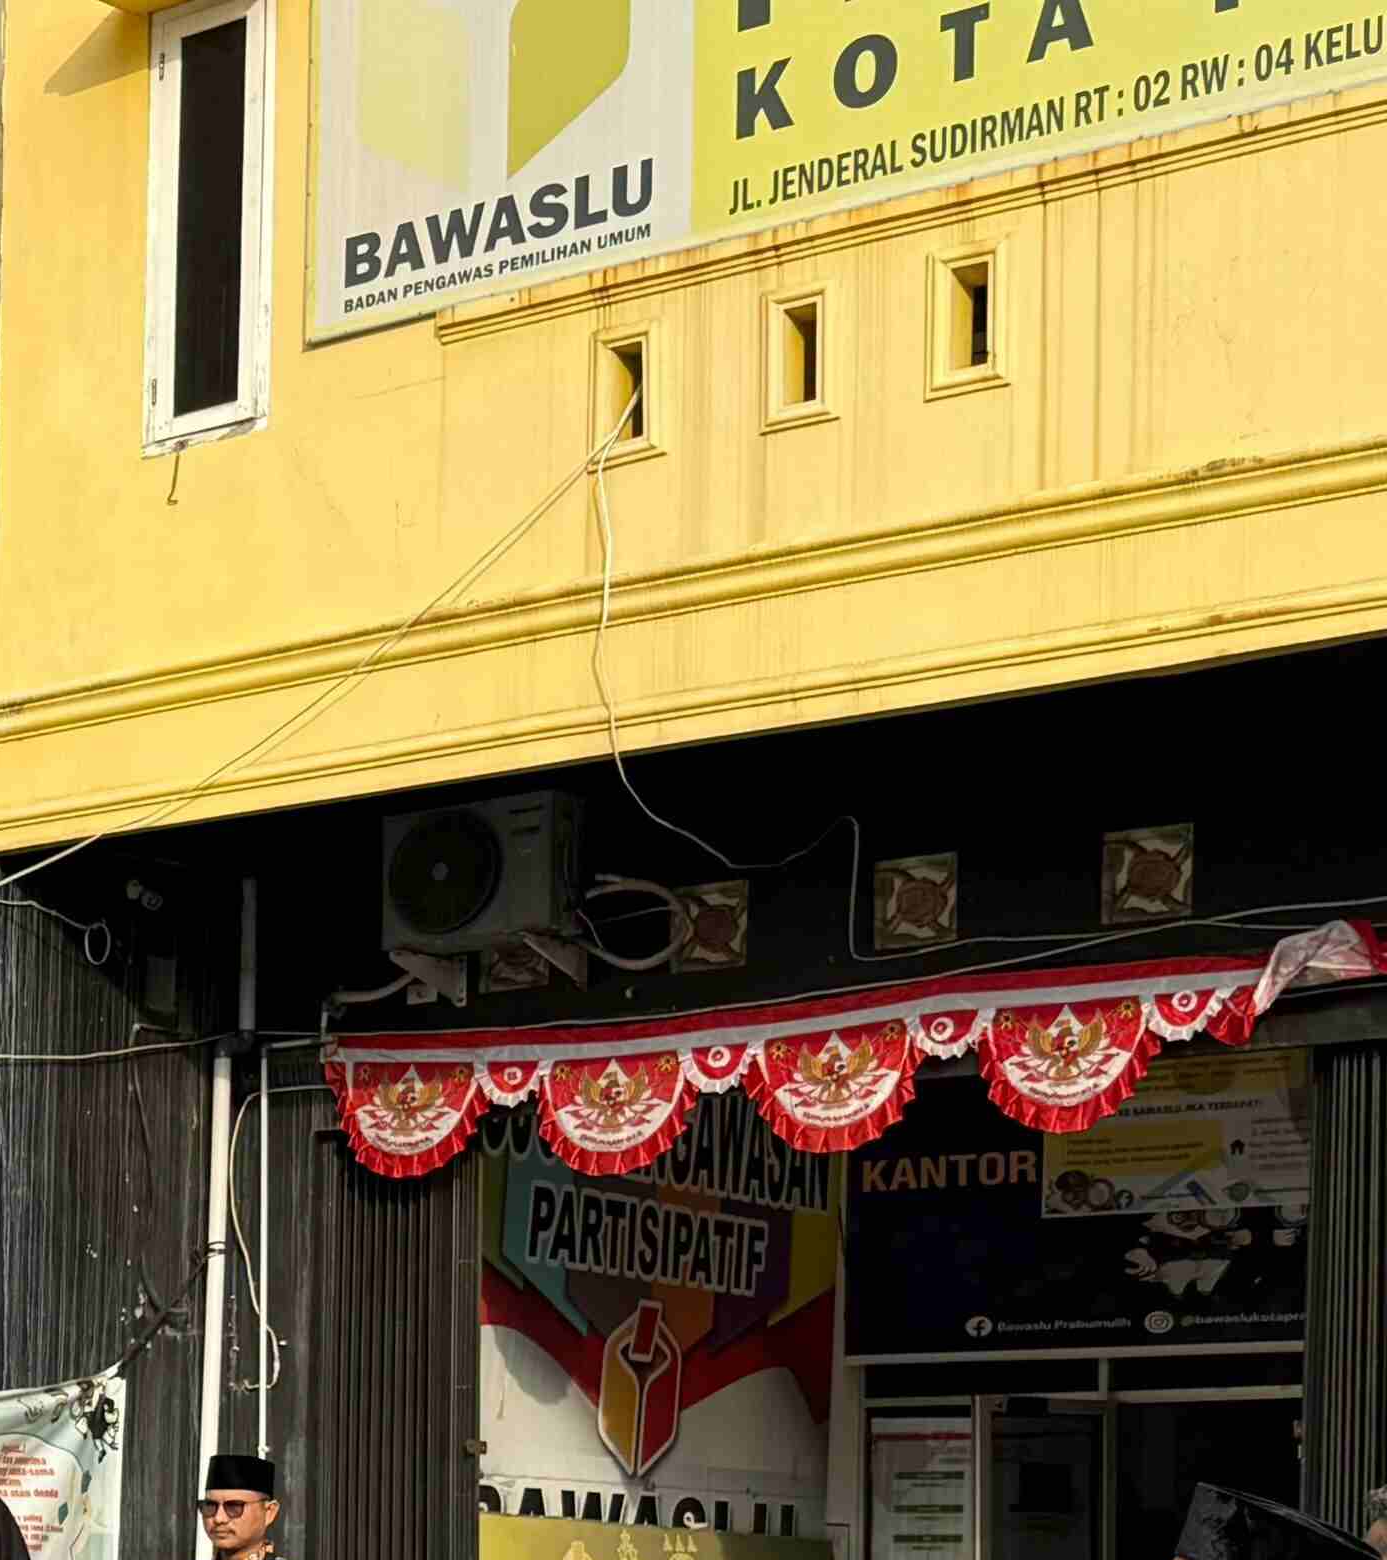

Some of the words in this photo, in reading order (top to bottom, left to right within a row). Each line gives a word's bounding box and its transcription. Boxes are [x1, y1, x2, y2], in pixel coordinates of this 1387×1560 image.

[728, 177, 762, 215] JL.
[768, 139, 904, 205] JENDERAL
[910, 96, 1064, 169] SUDIRMAN
[1074, 84, 1110, 127] RT
[1133, 70, 1171, 112] 02
[1180, 54, 1230, 100] RW
[1255, 38, 1295, 82] 04
[735, 0, 1094, 140] KOTA
[343, 287, 398, 314] BADAN
[402, 263, 494, 299] PENGAWAS
[498, 240, 592, 276] PEMILIHAN
[597, 223, 652, 250] UMUM
[344, 157, 654, 290] BAWASLU
[860, 1149, 1039, 1193] KANTOR
[525, 1180, 770, 1297] PARTISIPATIF
